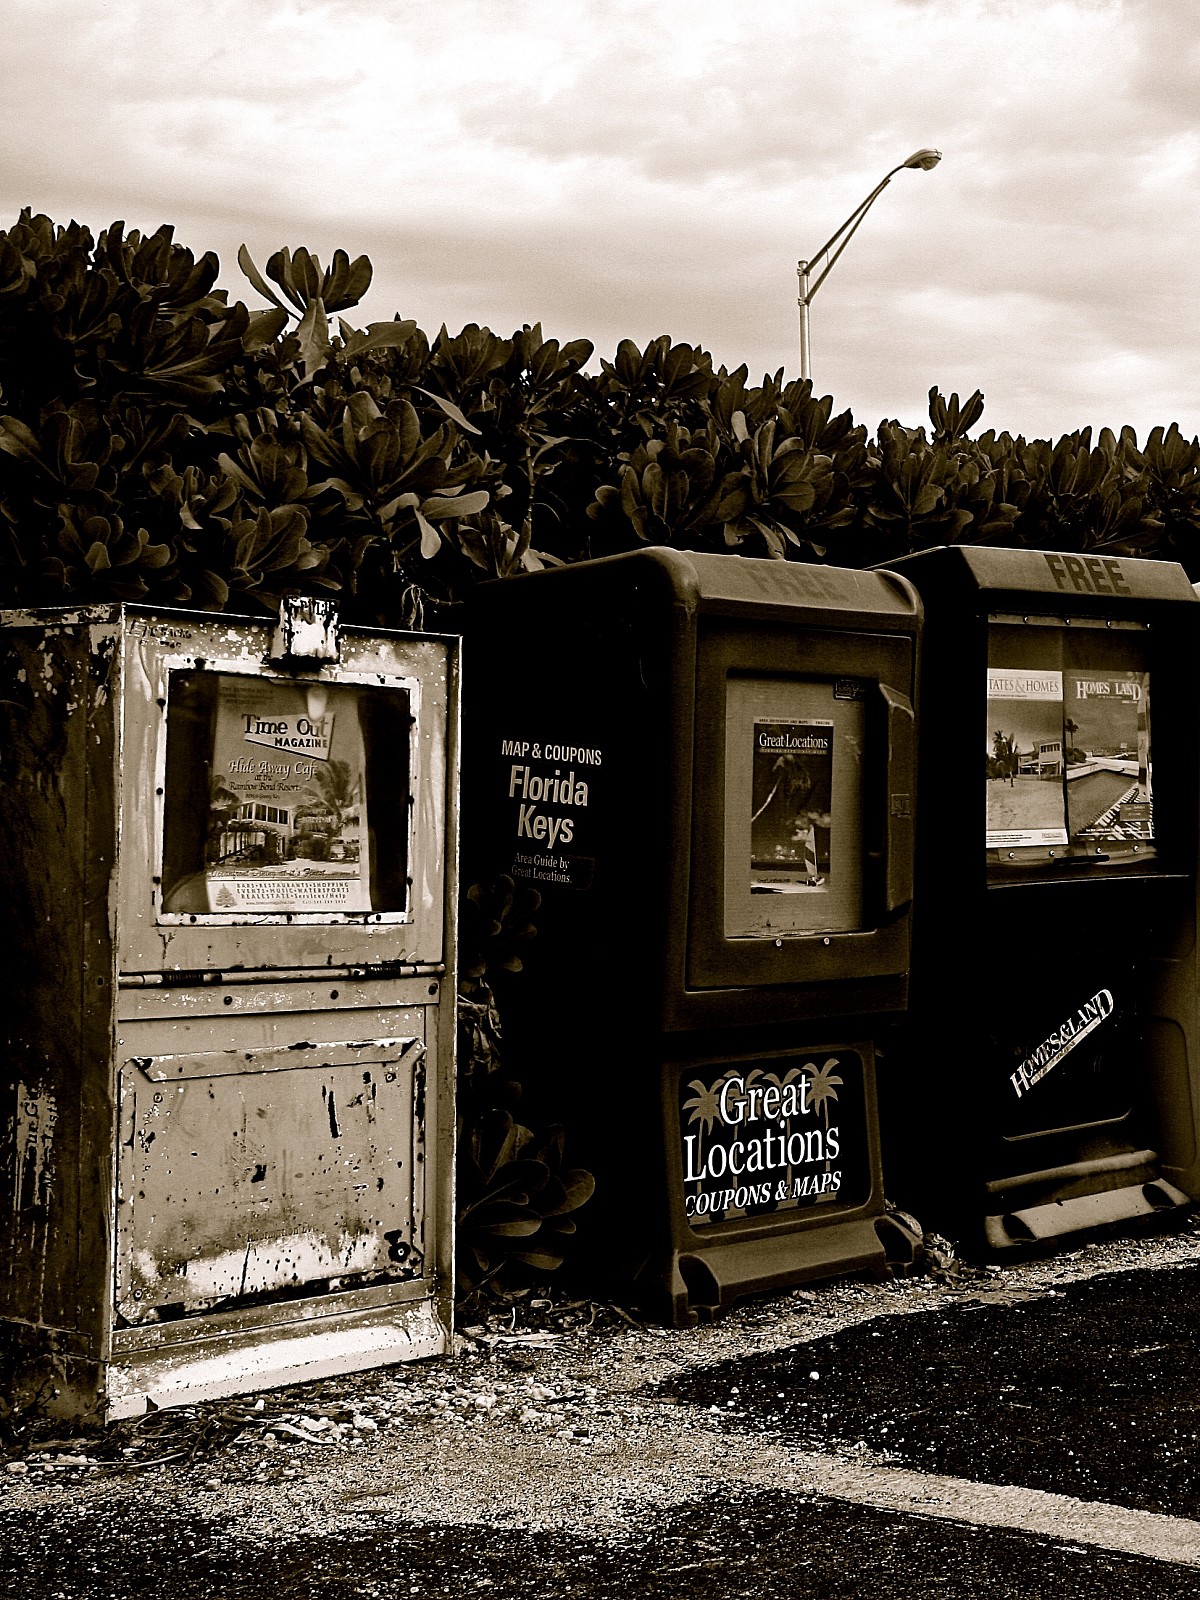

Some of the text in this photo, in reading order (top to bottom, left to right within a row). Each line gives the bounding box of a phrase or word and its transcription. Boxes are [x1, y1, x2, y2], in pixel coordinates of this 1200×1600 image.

[1043, 554, 1131, 595] FREE
[1026, 680, 1059, 693] HOMES
[1076, 681, 1110, 699] HOMES
[241, 713, 330, 738] Time Out
[274, 737, 328, 749] MAGAZINE
[759, 732, 828, 748] Great Locations
[501, 740, 602, 766] MAP & COUPONS
[228, 756, 256, 774] Hide
[258, 760, 291, 780] Away
[508, 765, 589, 806] Florida
[517, 803, 574, 849] Keys
[511, 865, 573, 884] Great Locations.
[514, 852, 570, 872] Area Guide by
[720, 1074, 811, 1125] Great
[684, 1120, 840, 1182] Locations
[685, 1170, 842, 1217] COUPONS & MAPS
